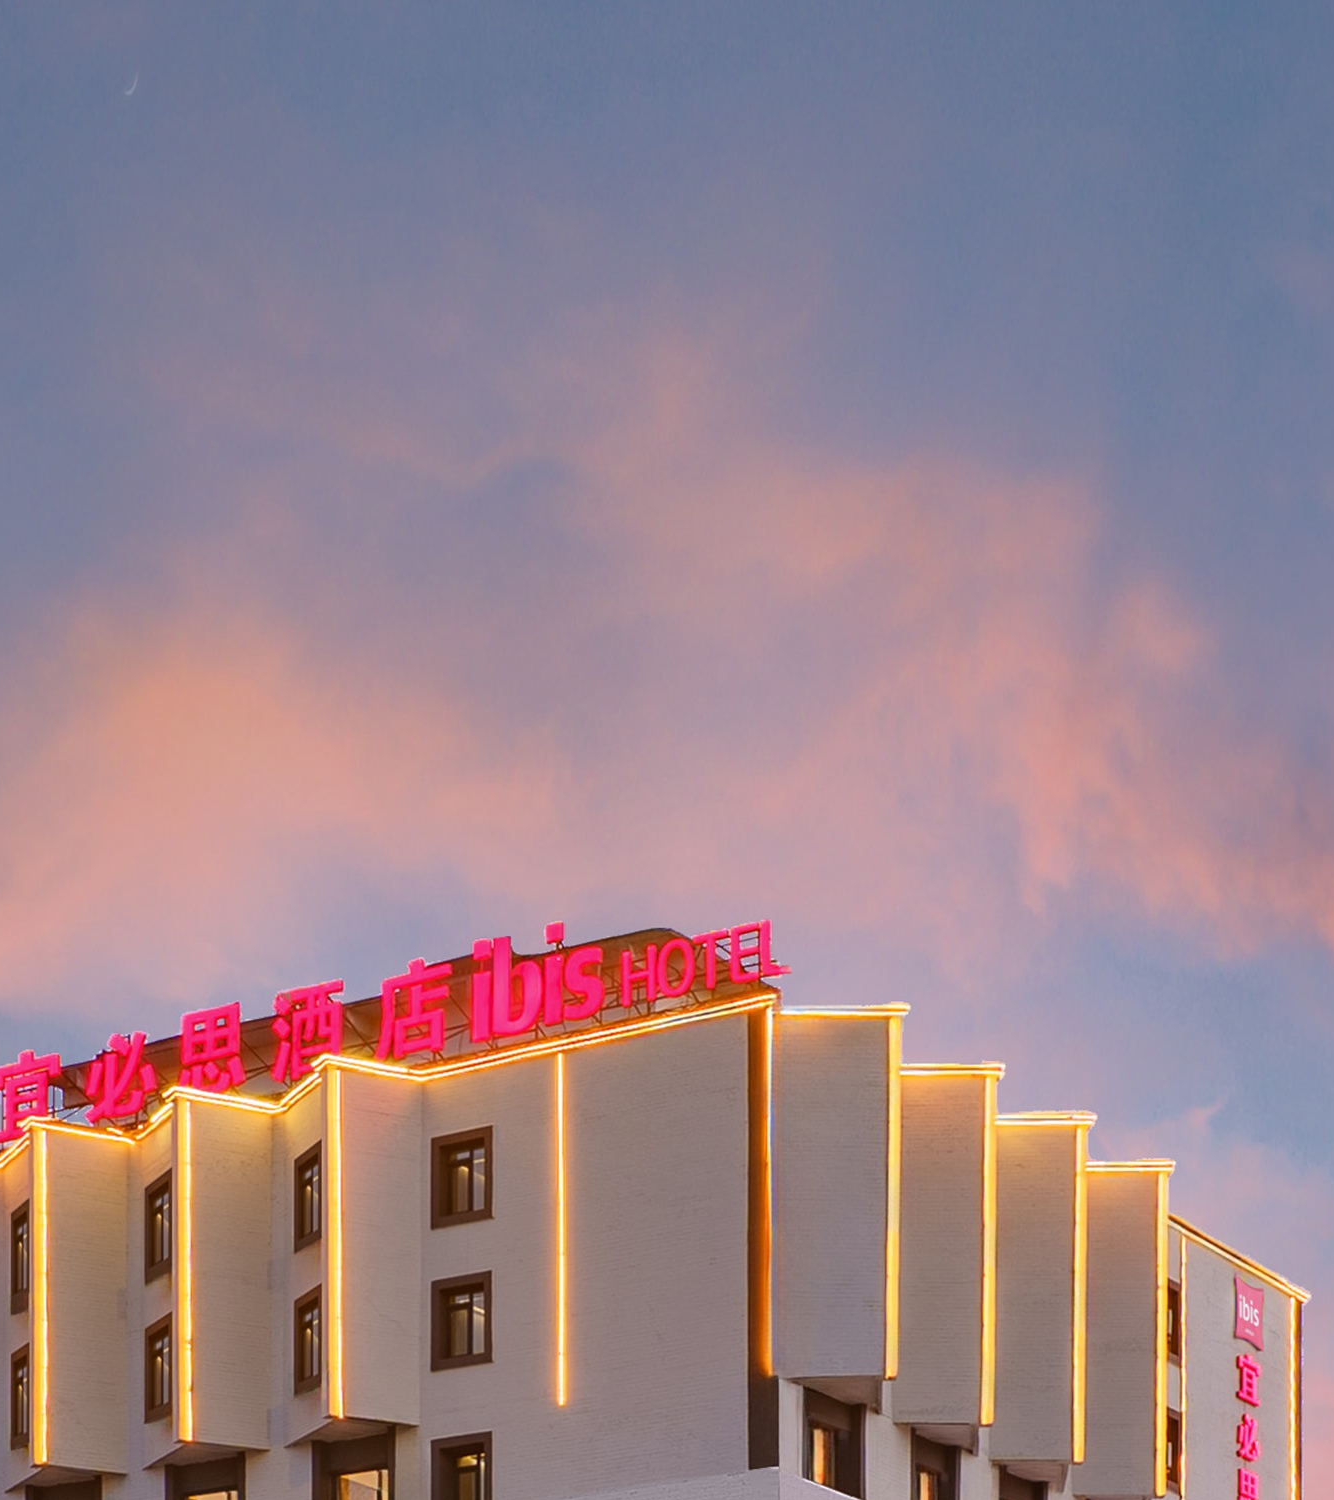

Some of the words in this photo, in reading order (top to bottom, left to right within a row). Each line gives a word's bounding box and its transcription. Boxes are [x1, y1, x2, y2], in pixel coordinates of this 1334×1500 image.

[470, 920, 606, 1044] ibis
[619, 919, 791, 1009] HOTEL
[1238, 1294, 1260, 1327] ibis
